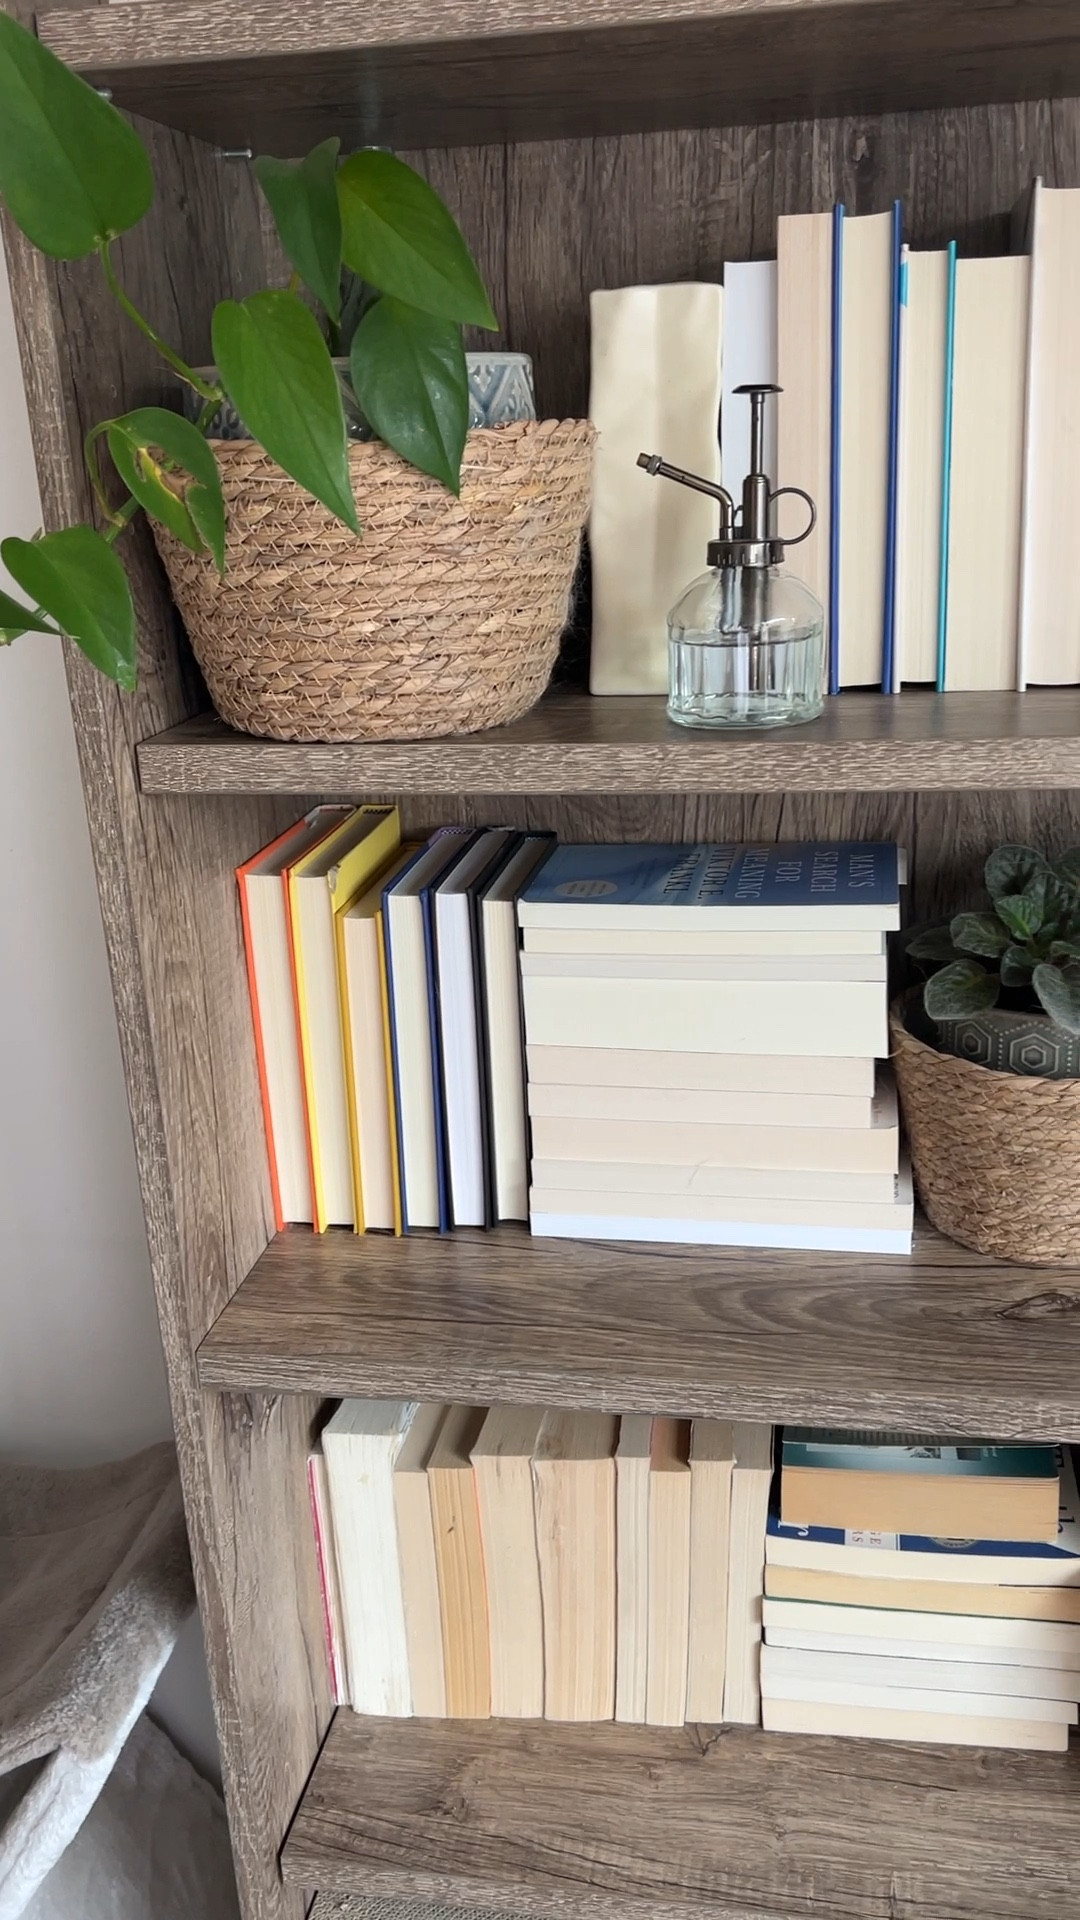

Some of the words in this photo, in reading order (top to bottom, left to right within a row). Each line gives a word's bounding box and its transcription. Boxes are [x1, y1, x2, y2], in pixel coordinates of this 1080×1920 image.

[663, 853, 701, 894] FRANKL
[703, 848, 737, 886] VIKTOR
[734, 848, 770, 898] MEANING
[775, 861, 803, 882] FOR
[810, 851, 839, 892] SEARCH
[848, 854, 876, 888] MAN'S
[697, 890, 724, 900] E.
